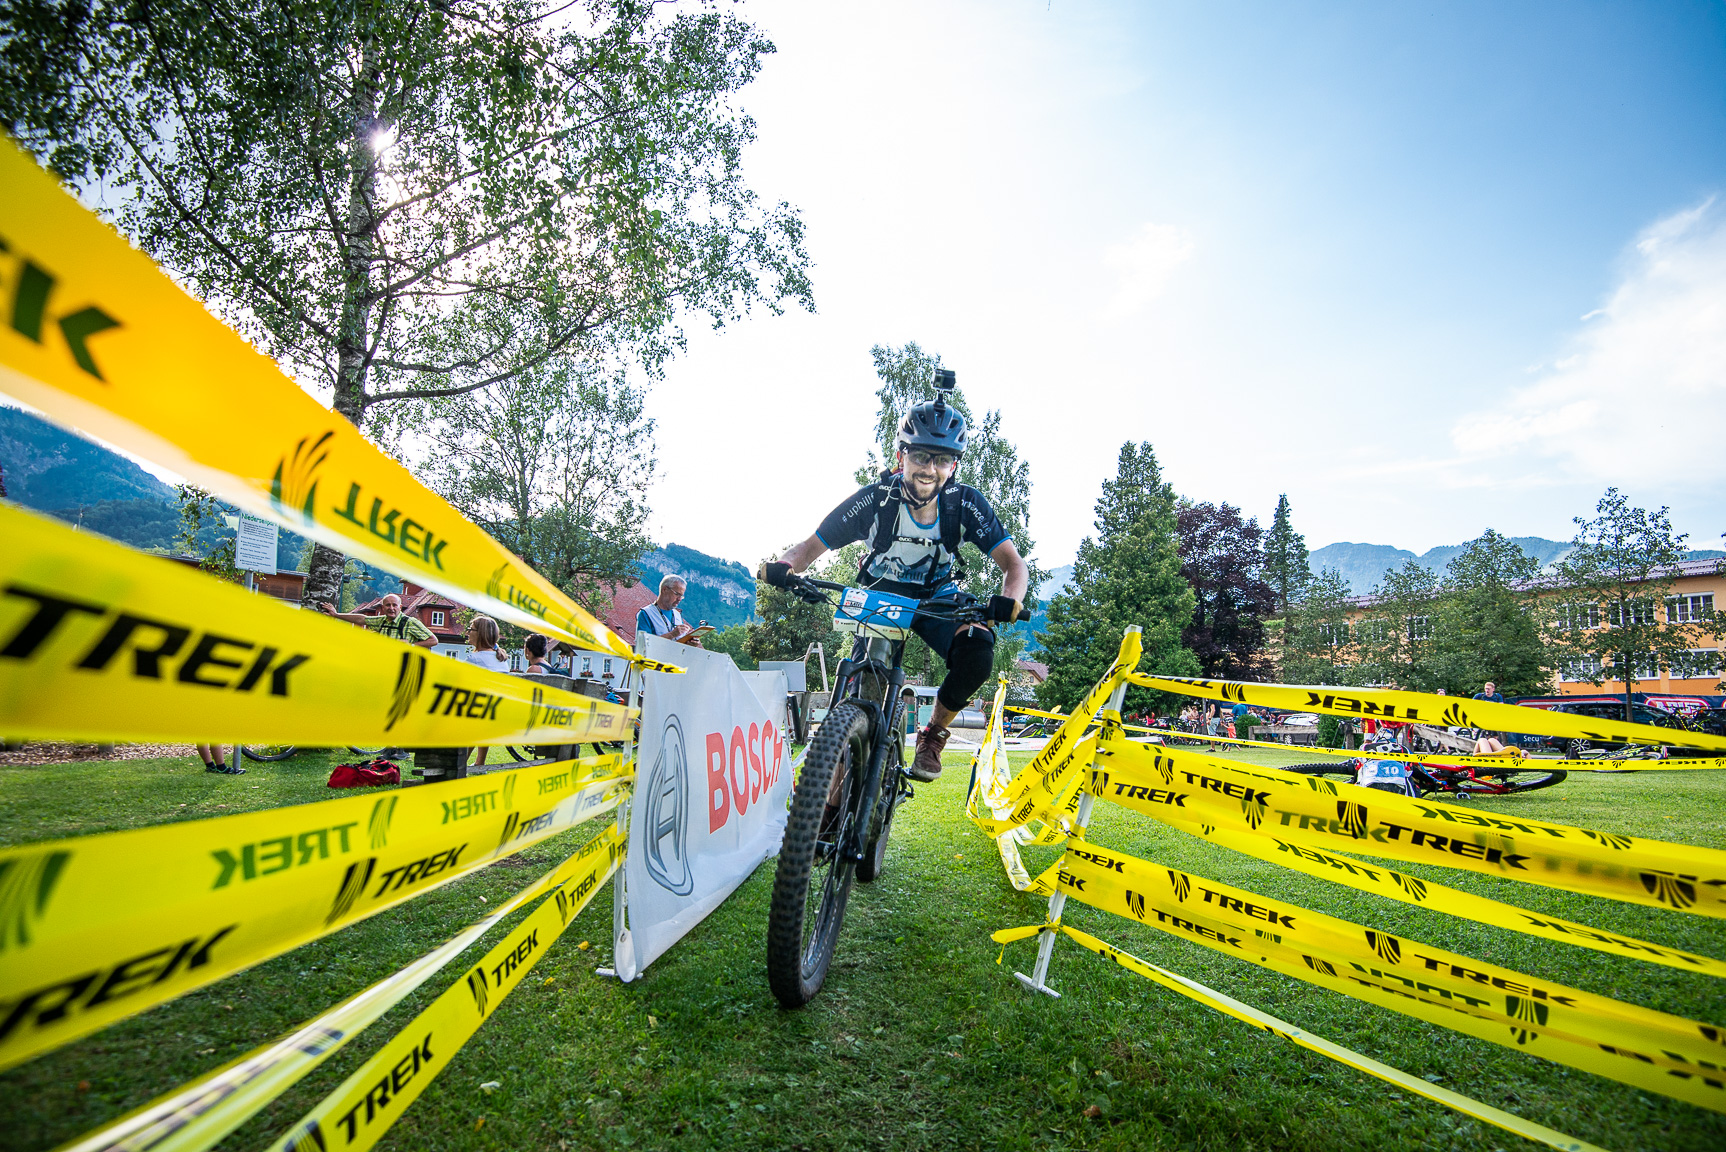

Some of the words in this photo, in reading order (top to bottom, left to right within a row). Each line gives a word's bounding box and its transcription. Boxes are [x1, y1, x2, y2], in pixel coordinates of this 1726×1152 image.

[2, 584, 313, 698] TREK
[427, 683, 503, 720] TREK
[541, 705, 575, 726] TREK
[1305, 692, 1430, 722] TREK
[594, 713, 615, 728] TREK
[1042, 729, 1068, 766] TREK
[706, 720, 783, 834] BOSCH
[1050, 753, 1075, 783] TREK
[1384, 766, 1399, 775] 10
[582, 791, 606, 811] TREK
[1114, 782, 1190, 808] TREK
[1180, 770, 1272, 808] TREK
[516, 808, 558, 840] TREK
[1017, 798, 1035, 822] TREK
[1379, 821, 1531, 871] TREK
[374, 842, 470, 899] TREK
[568, 869, 597, 908] TREK
[1198, 887, 1297, 930] TREK
[1152, 908, 1244, 949] TREK
[492, 928, 539, 988] TREK
[1415, 954, 1578, 1008] TREK
[336, 1032, 434, 1145] TREK
